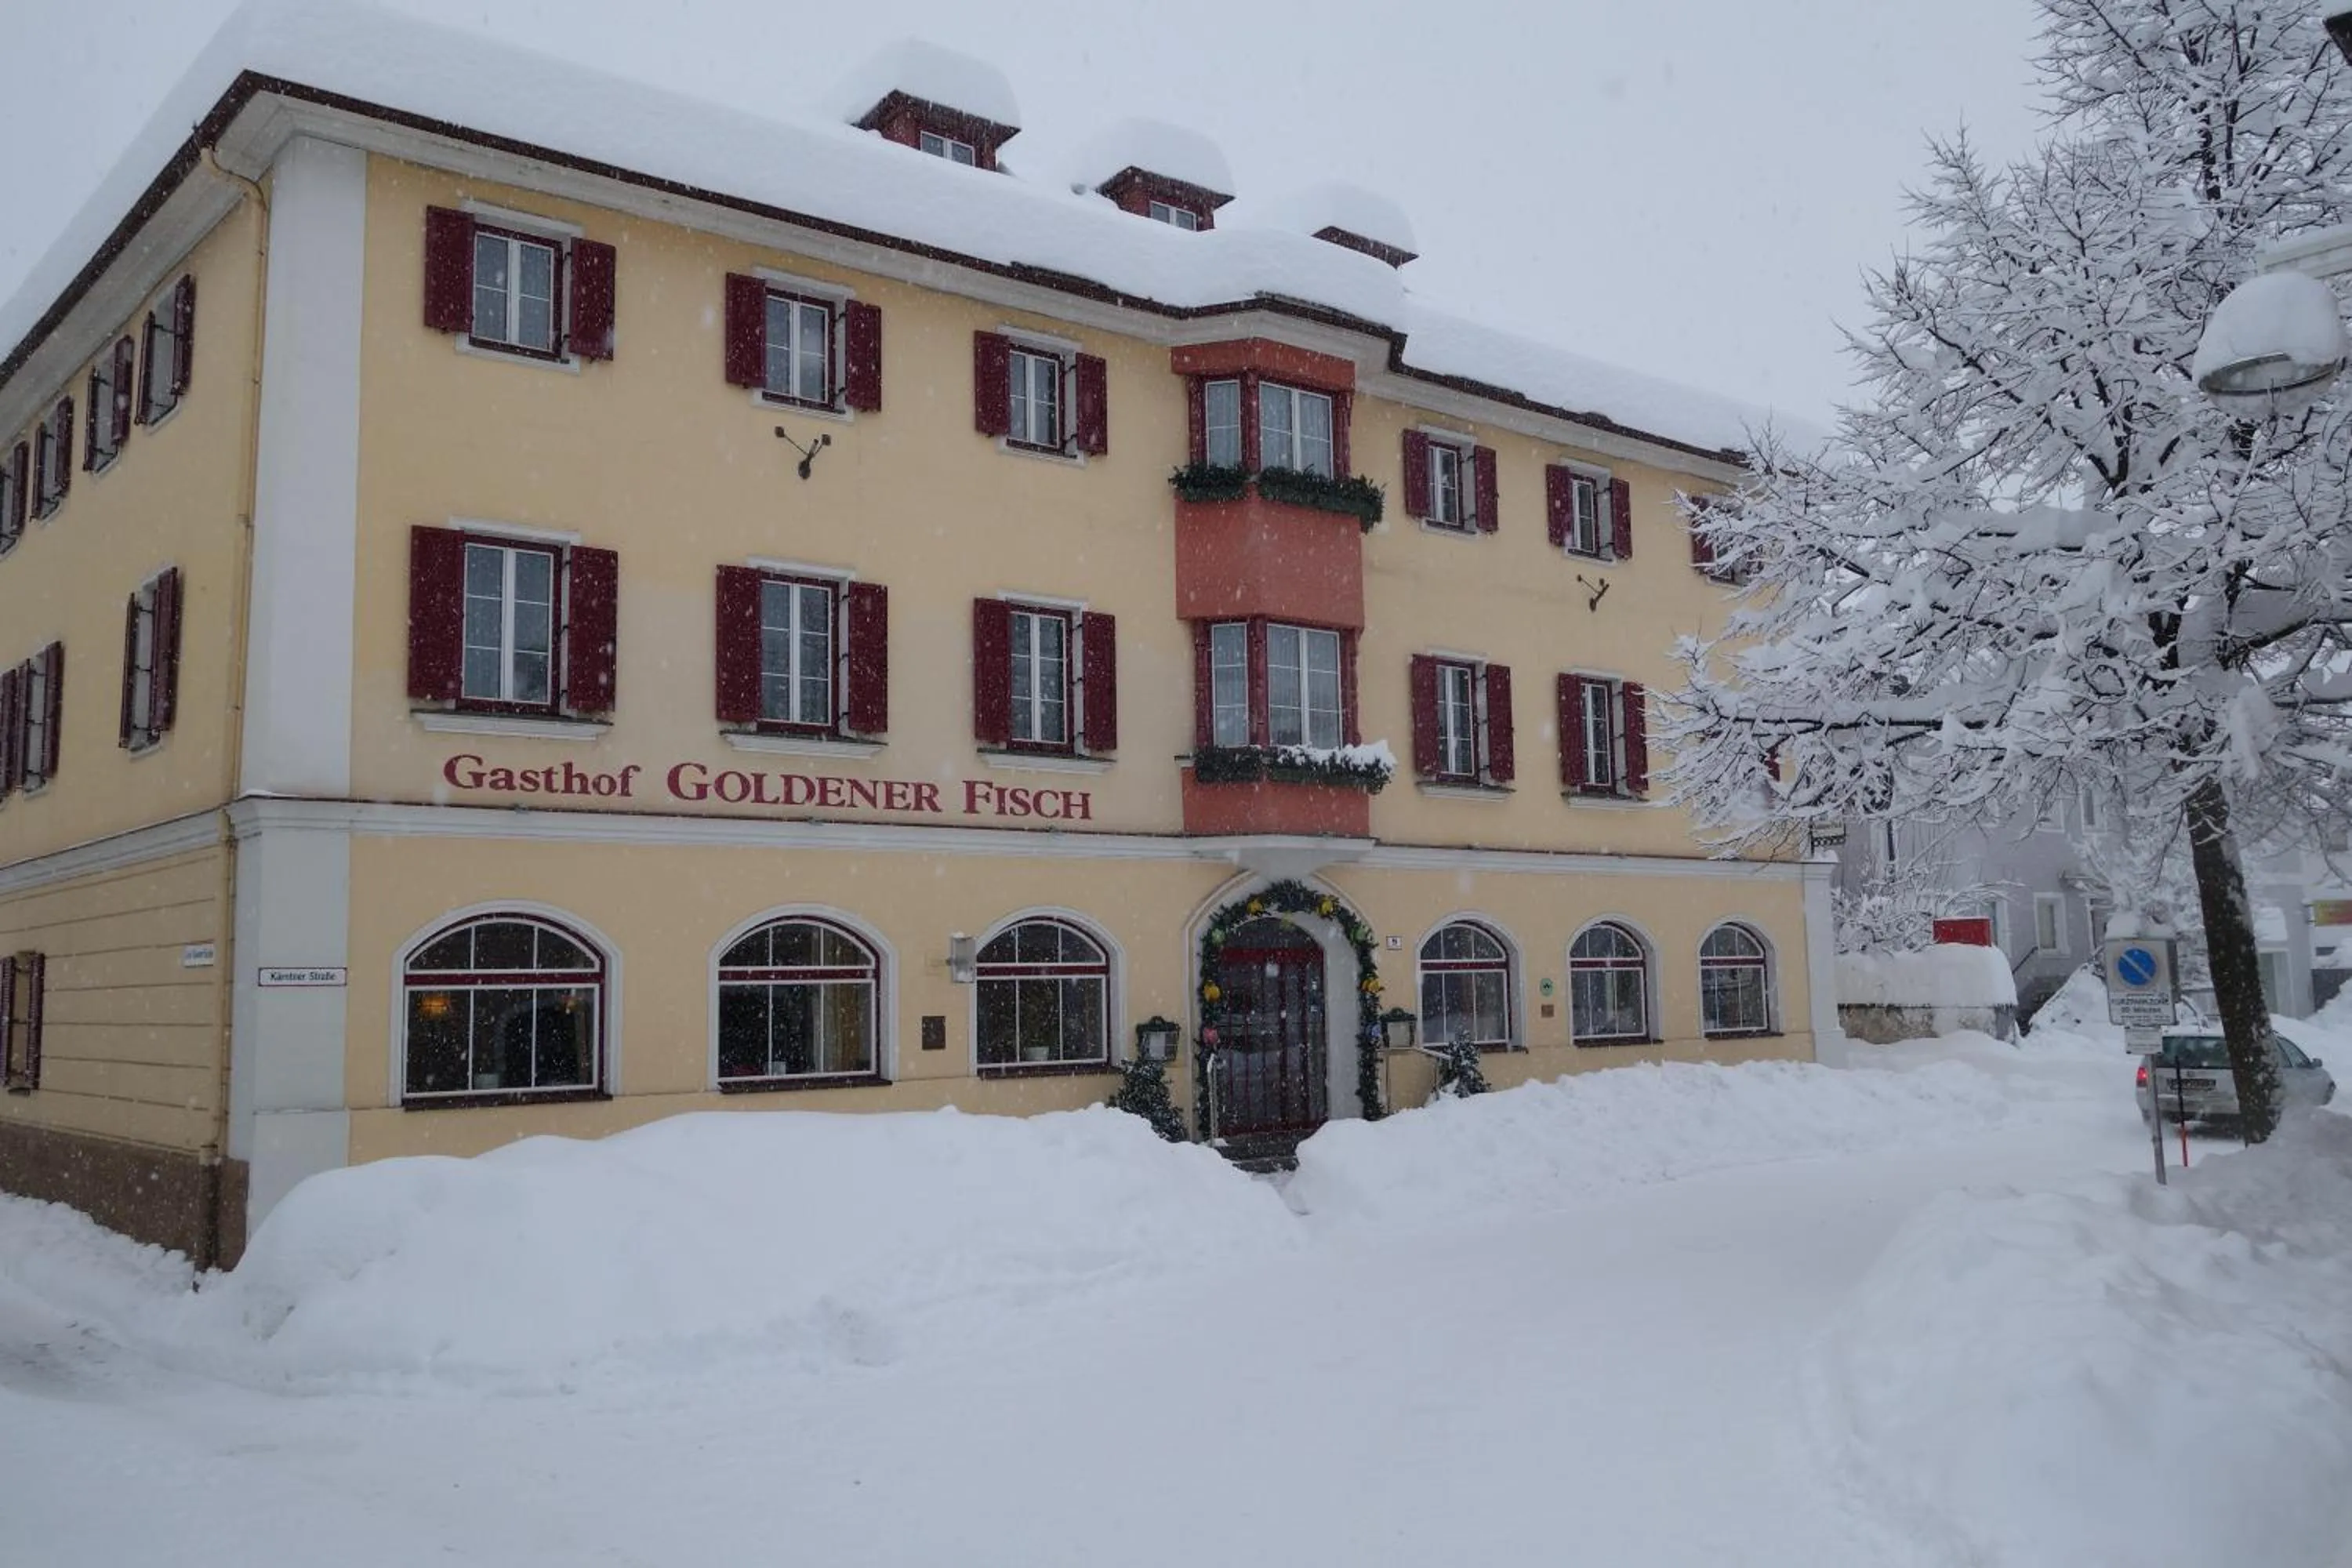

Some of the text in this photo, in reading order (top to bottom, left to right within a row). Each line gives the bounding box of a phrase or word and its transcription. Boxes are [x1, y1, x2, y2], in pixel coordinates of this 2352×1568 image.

[443, 753, 1091, 820] Gasthof GOLDENER FISCH
